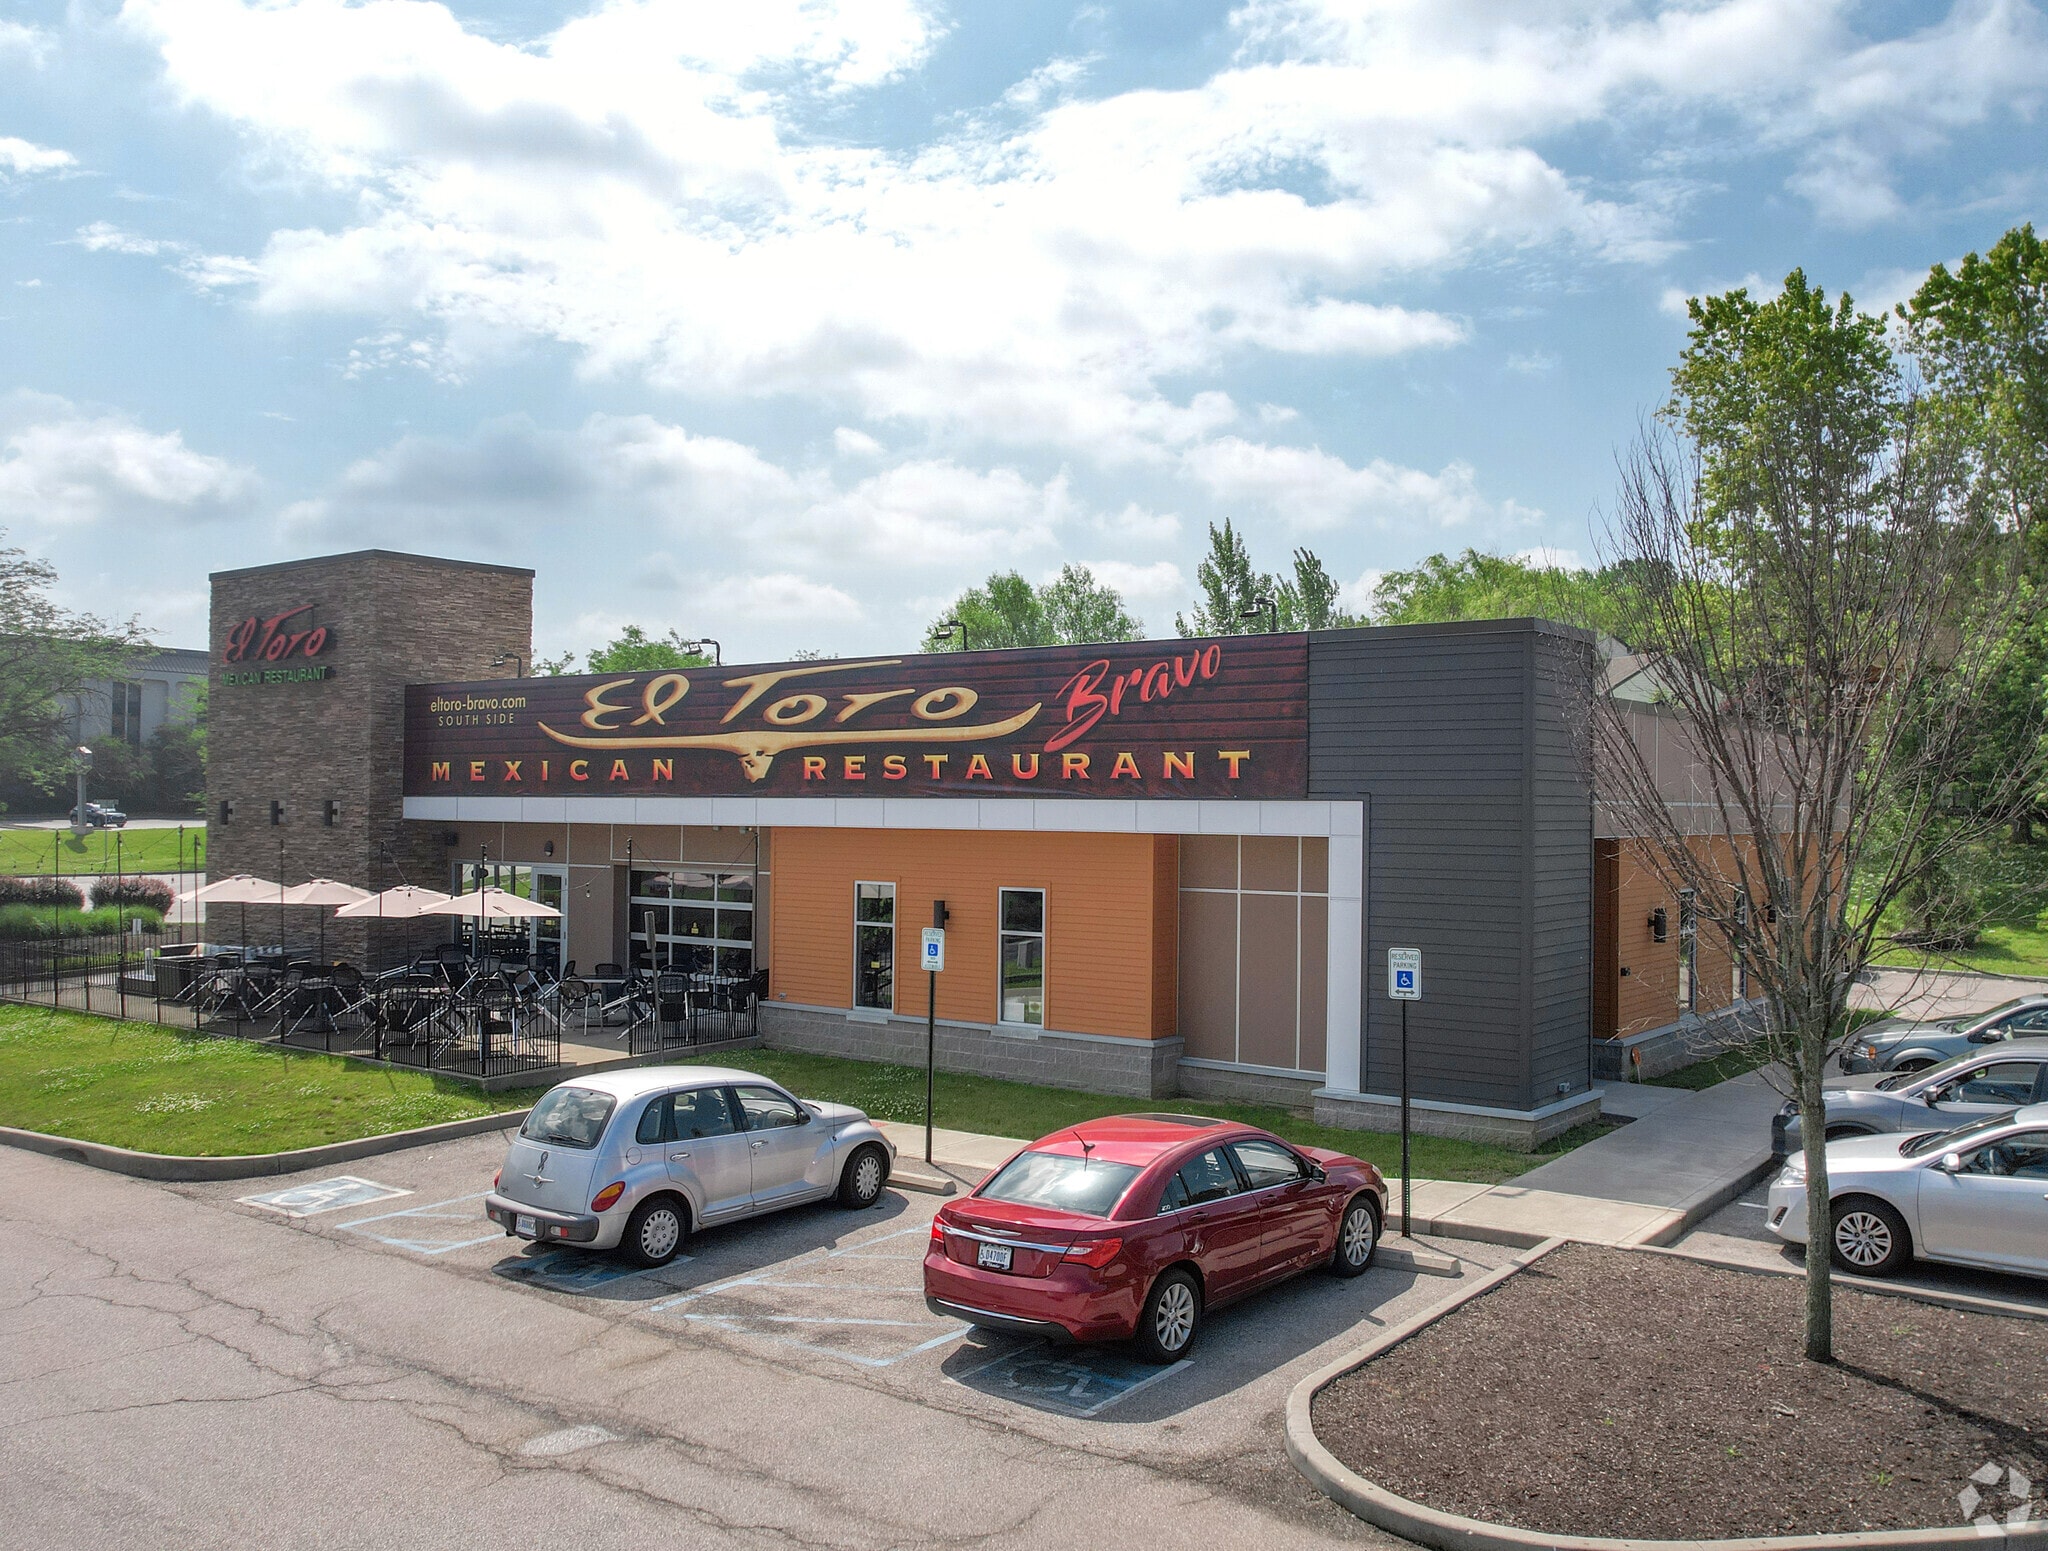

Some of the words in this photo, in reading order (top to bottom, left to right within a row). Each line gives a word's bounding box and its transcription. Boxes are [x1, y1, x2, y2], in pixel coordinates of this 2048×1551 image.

[223, 616, 257, 664] El
[255, 604, 327, 660] Toro
[264, 666, 327, 685] RESTAURANT
[430, 695, 526, 713] eltoro-bravo.com
[580, 673, 690, 730] El
[719, 660, 979, 726] Toro
[1044, 644, 1221, 752] Bravo
[438, 714, 479, 727] SOUTH
[486, 712, 515, 725] SIDE
[431, 758, 673, 781] MEXICAN
[803, 749, 1250, 781] RESTAURANT
